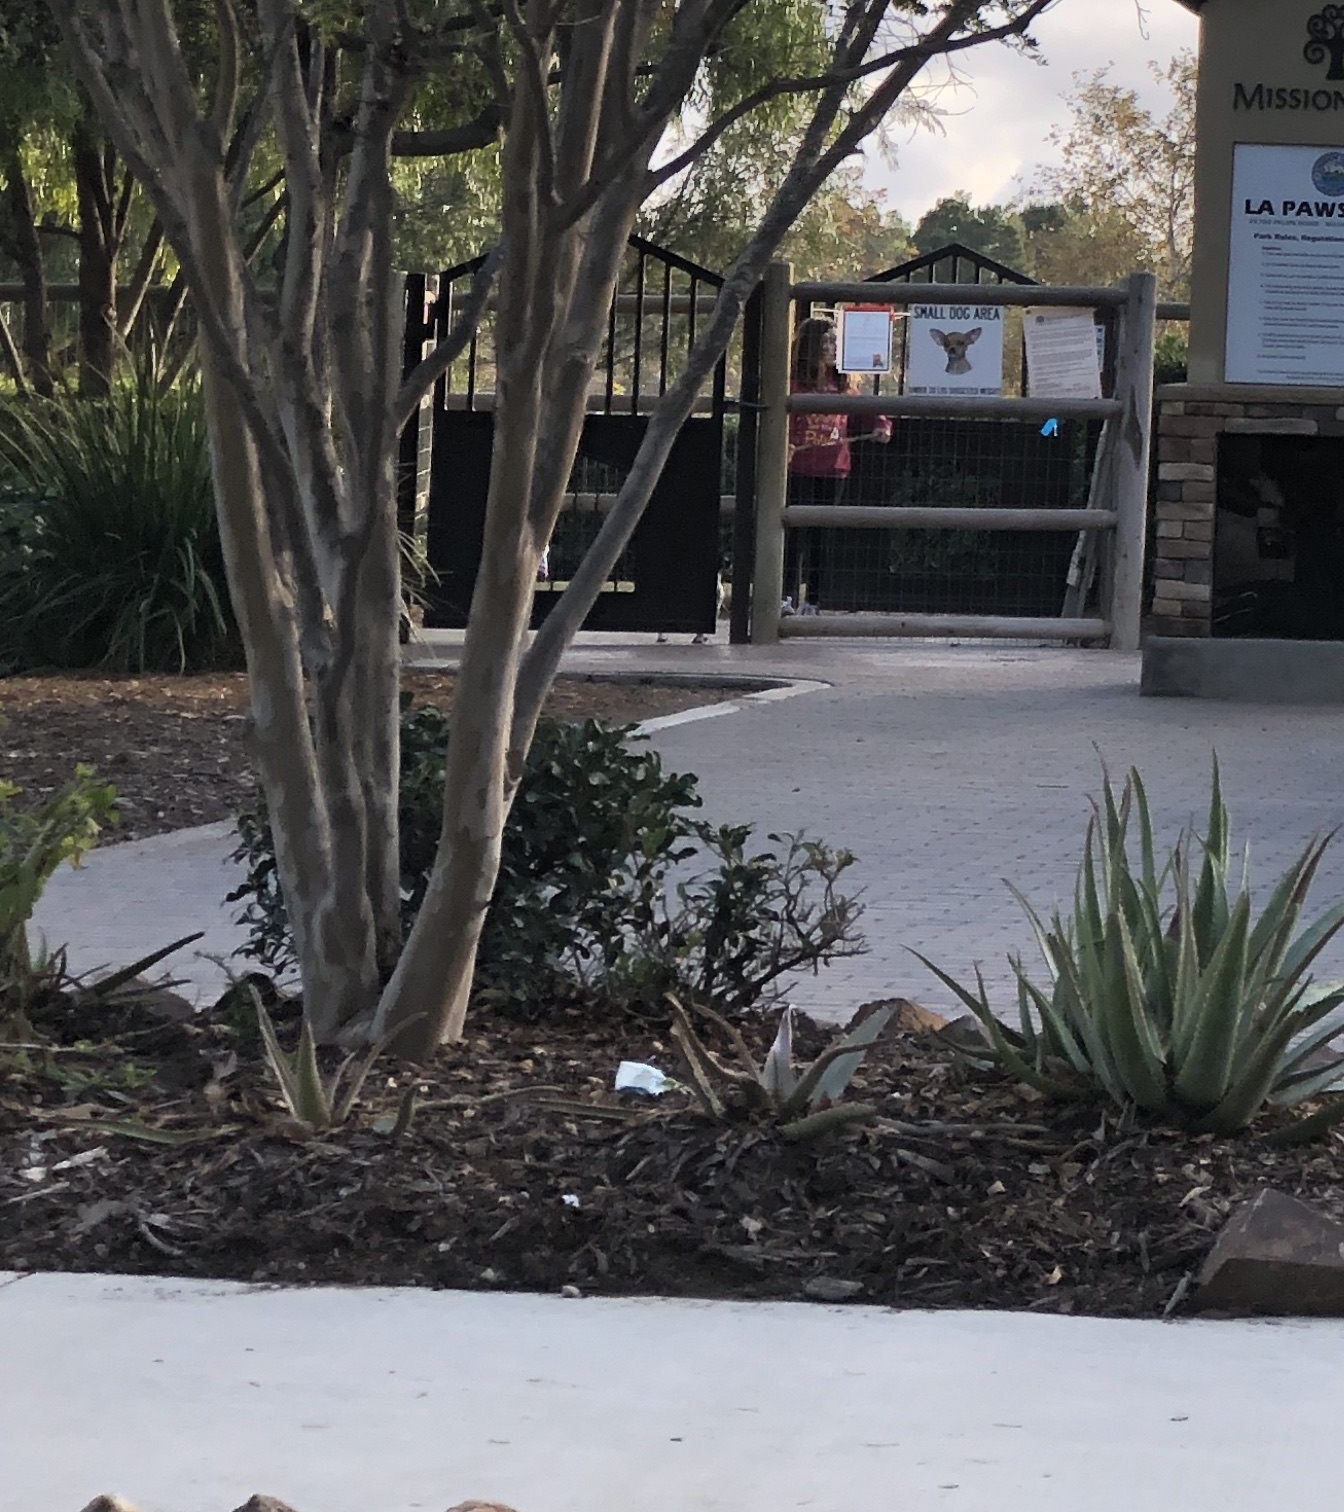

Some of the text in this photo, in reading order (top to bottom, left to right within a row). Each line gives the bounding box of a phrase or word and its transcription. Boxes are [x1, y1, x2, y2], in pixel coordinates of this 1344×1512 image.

[1244, 198, 1275, 216] LA
[913, 305, 1000, 321] SMALL DOG AREA
